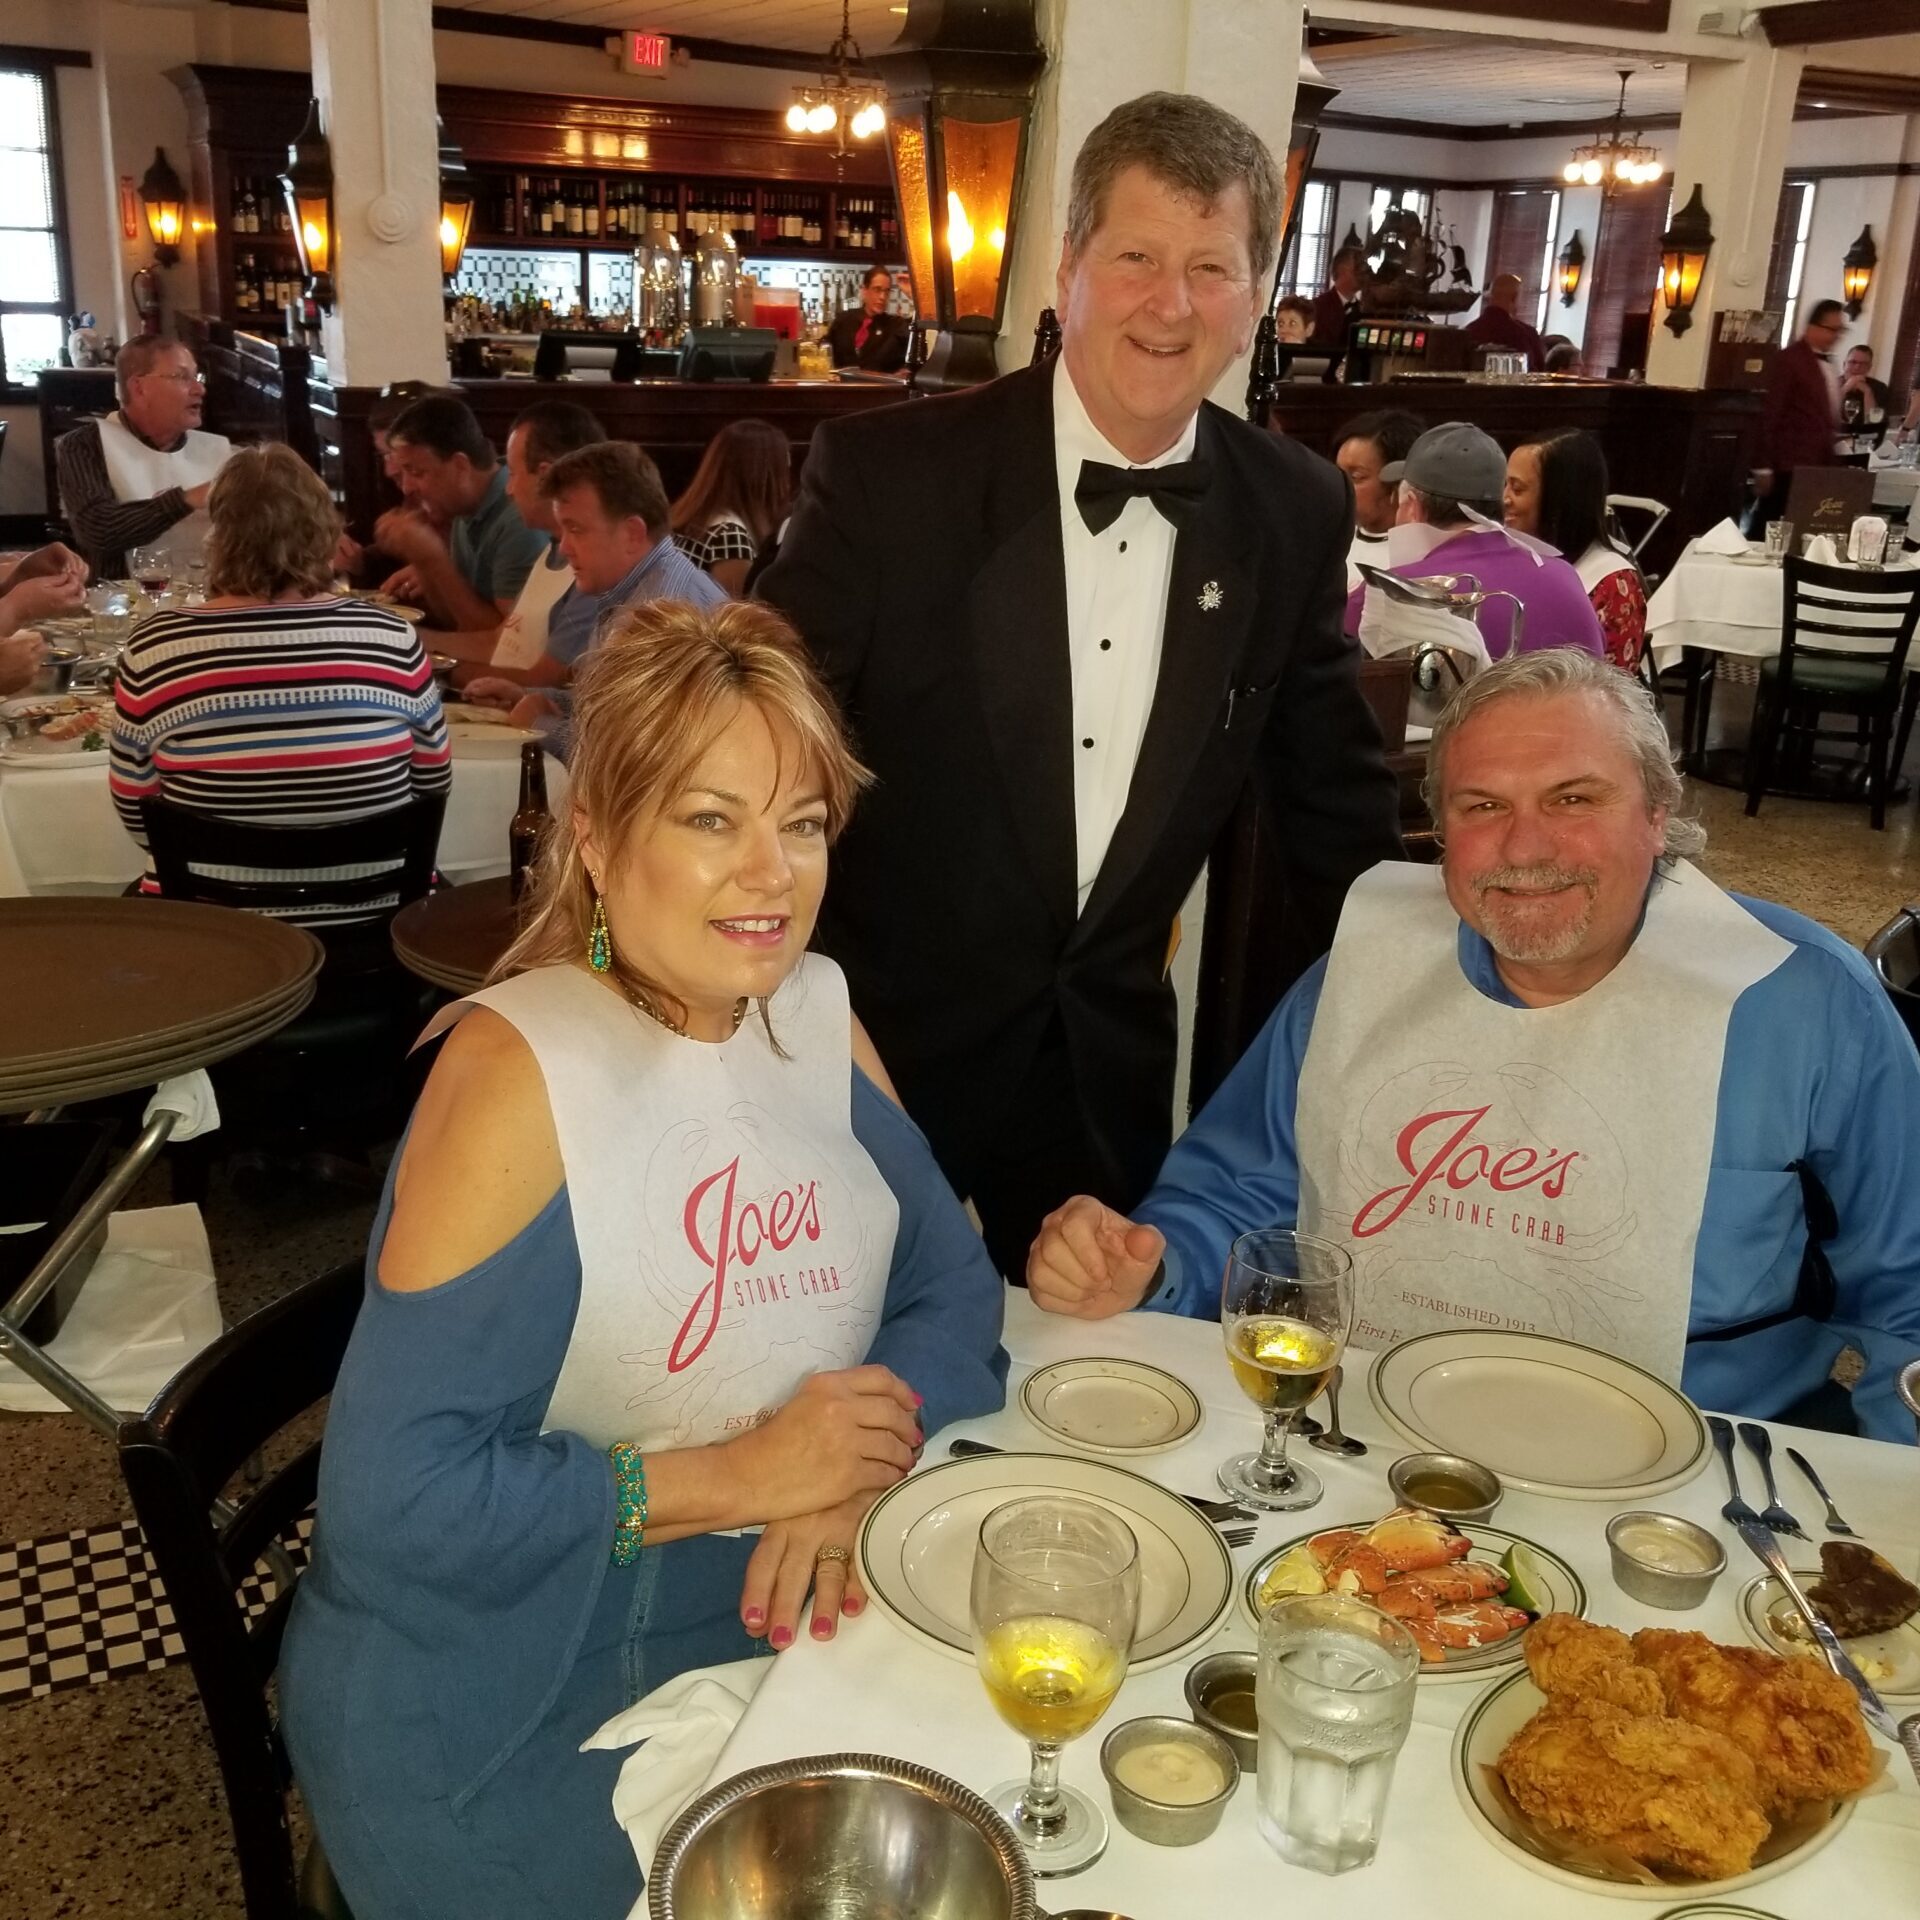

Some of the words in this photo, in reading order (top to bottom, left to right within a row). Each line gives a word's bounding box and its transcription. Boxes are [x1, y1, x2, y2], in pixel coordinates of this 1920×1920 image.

[635, 36, 665, 67] EXIT
[1351, 1103, 1580, 1238] Joe's
[1428, 1194, 1495, 1228] STONE
[1511, 1213, 1565, 1246] CRAB
[667, 1154, 821, 1373] Joe's
[734, 1273, 791, 1307] STONE
[798, 1265, 841, 1296] CRAB
[1355, 1318, 1387, 1339] First
[1401, 1290, 1501, 1326] ESTABLISHED
[1505, 1318, 1536, 1333] 1913
